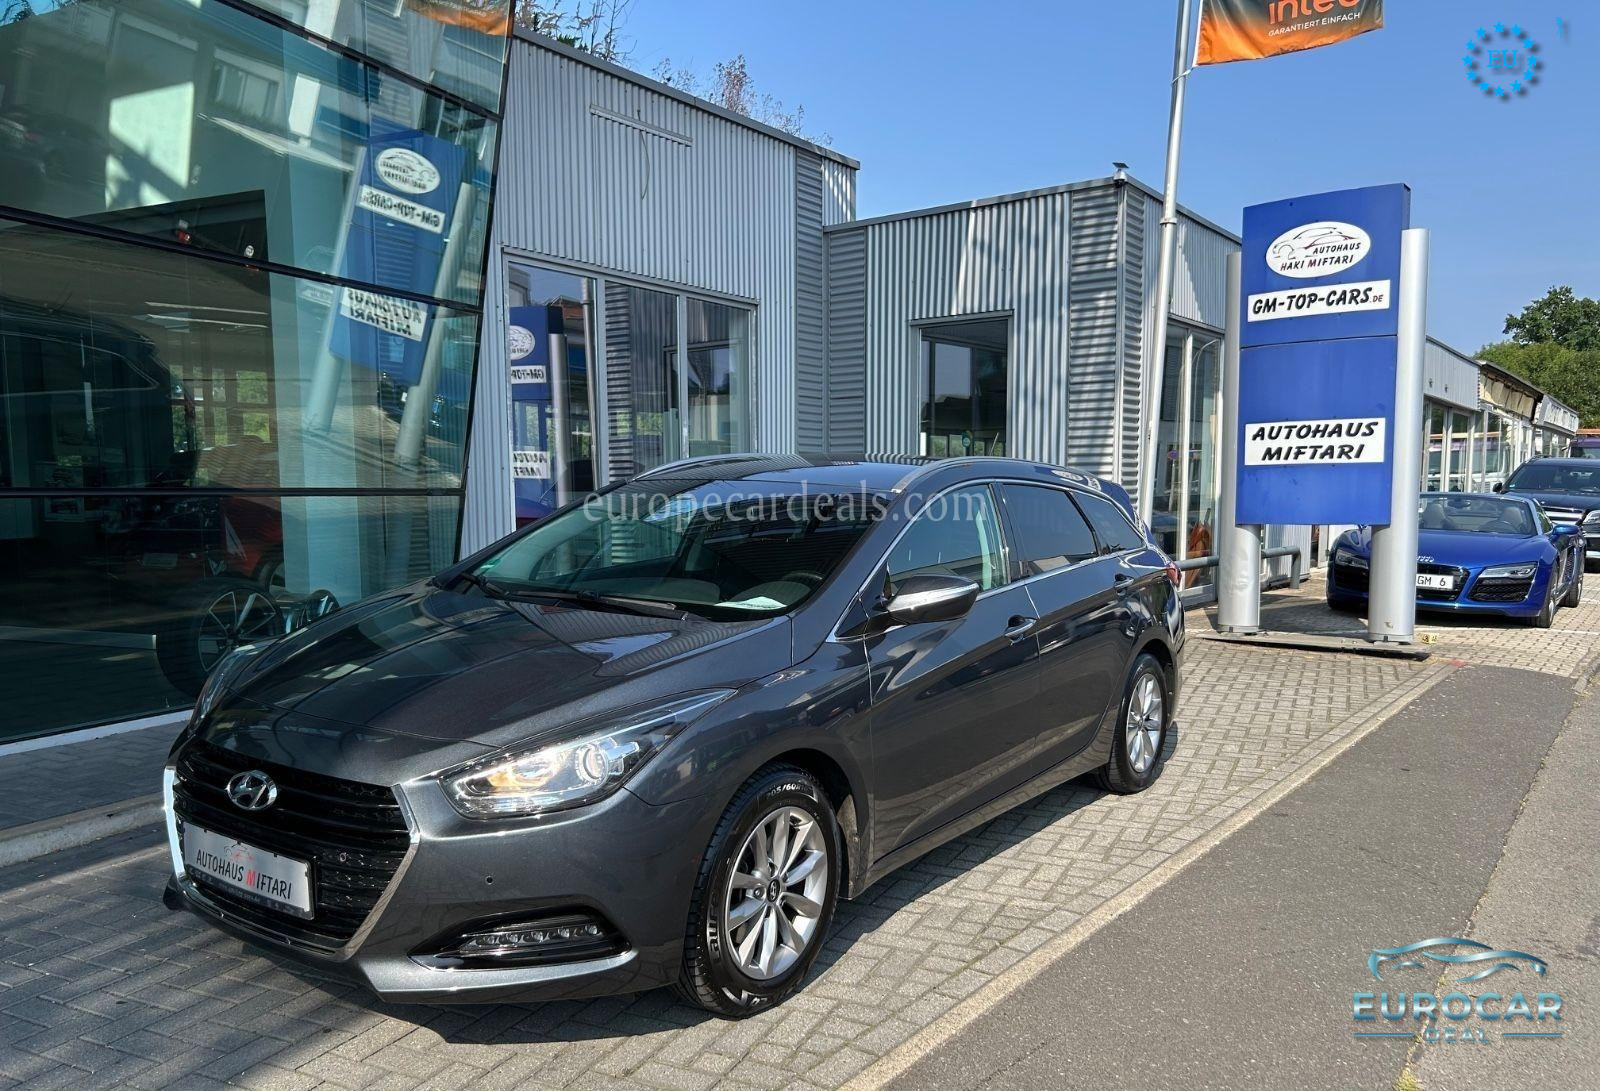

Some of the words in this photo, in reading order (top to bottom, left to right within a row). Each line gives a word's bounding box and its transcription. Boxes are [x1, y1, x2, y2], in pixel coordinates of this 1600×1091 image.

[1268, 19, 1319, 37] GARANTIERT
[1321, 12, 1361, 26] EINFACH
[1313, 242, 1362, 255] AUTOHAUS
[1280, 259, 1304, 272] HAKI
[1307, 254, 1355, 268] MIFTARI
[1251, 420, 1379, 441] AUTOHAUS
[1261, 443, 1366, 461] MIFTARI
[1417, 575, 1432, 586] GM
[1439, 577, 1446, 587] 6
[196, 849, 244, 882] AUTOHAUS
[246, 868, 292, 900] MIFTARI
